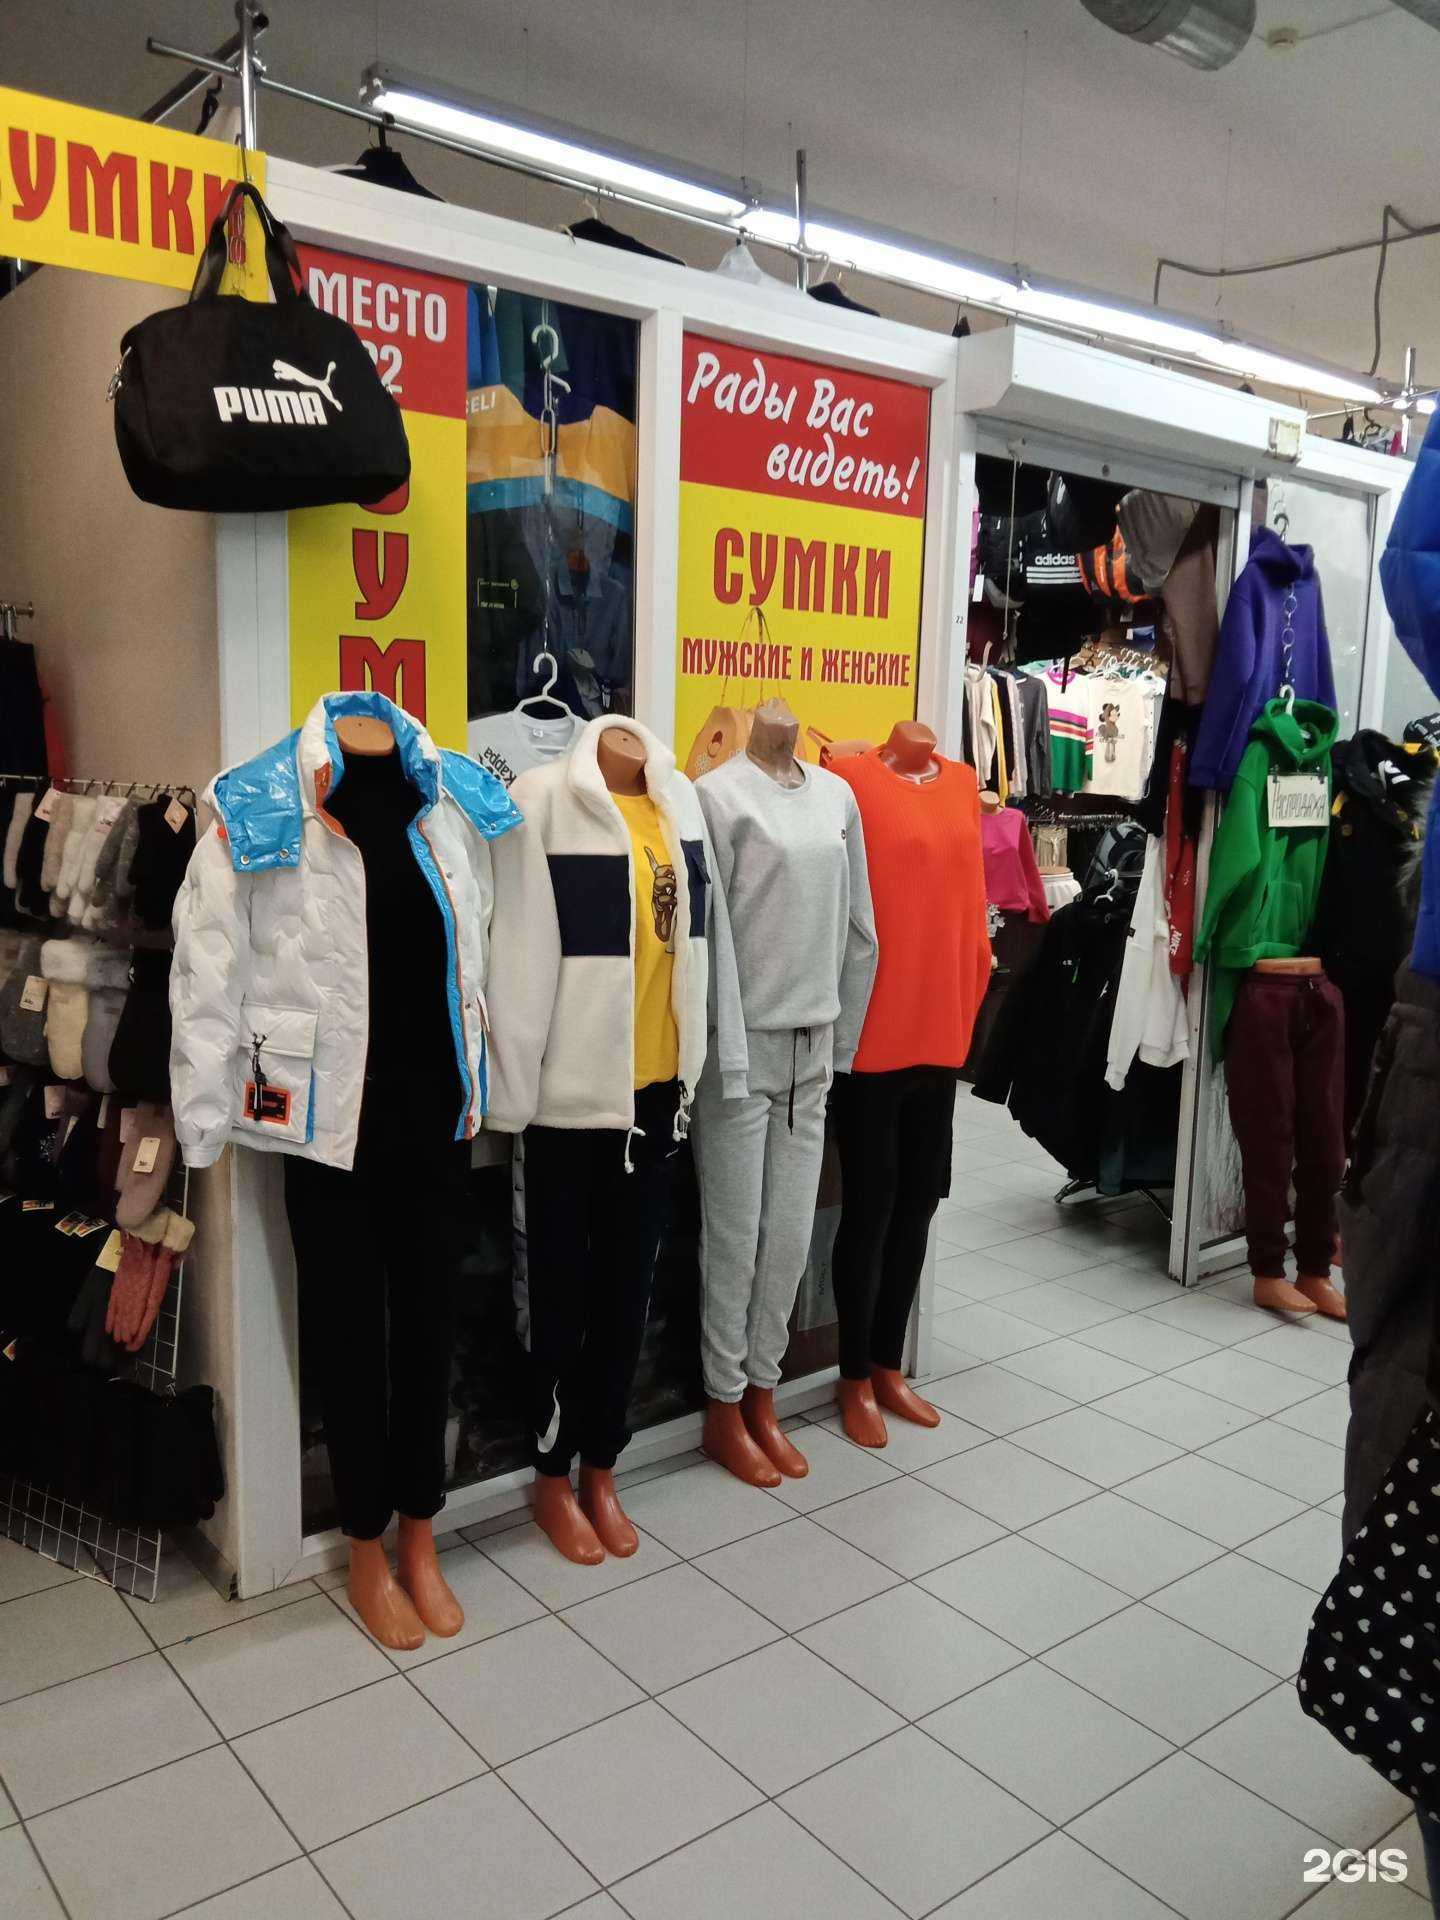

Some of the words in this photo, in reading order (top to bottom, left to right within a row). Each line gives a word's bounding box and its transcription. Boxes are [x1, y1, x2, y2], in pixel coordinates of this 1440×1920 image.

[0, 127, 246, 265] УМКИ
[309, 267, 447, 343] МЕСТО
[213, 386, 328, 425] PUMA
[687, 352, 797, 424] Рады
[806, 378, 874, 437] Вас
[767, 432, 920, 505] видеть!
[713, 527, 891, 619] СУМКИ
[1034, 553, 1076, 566] adidas
[682, 637, 793, 680] МУЖСКИЕ
[800, 647, 813, 681] И
[820, 648, 911, 687] ЖЕНСКИЕ
[483, 746, 518, 786] Kappa
